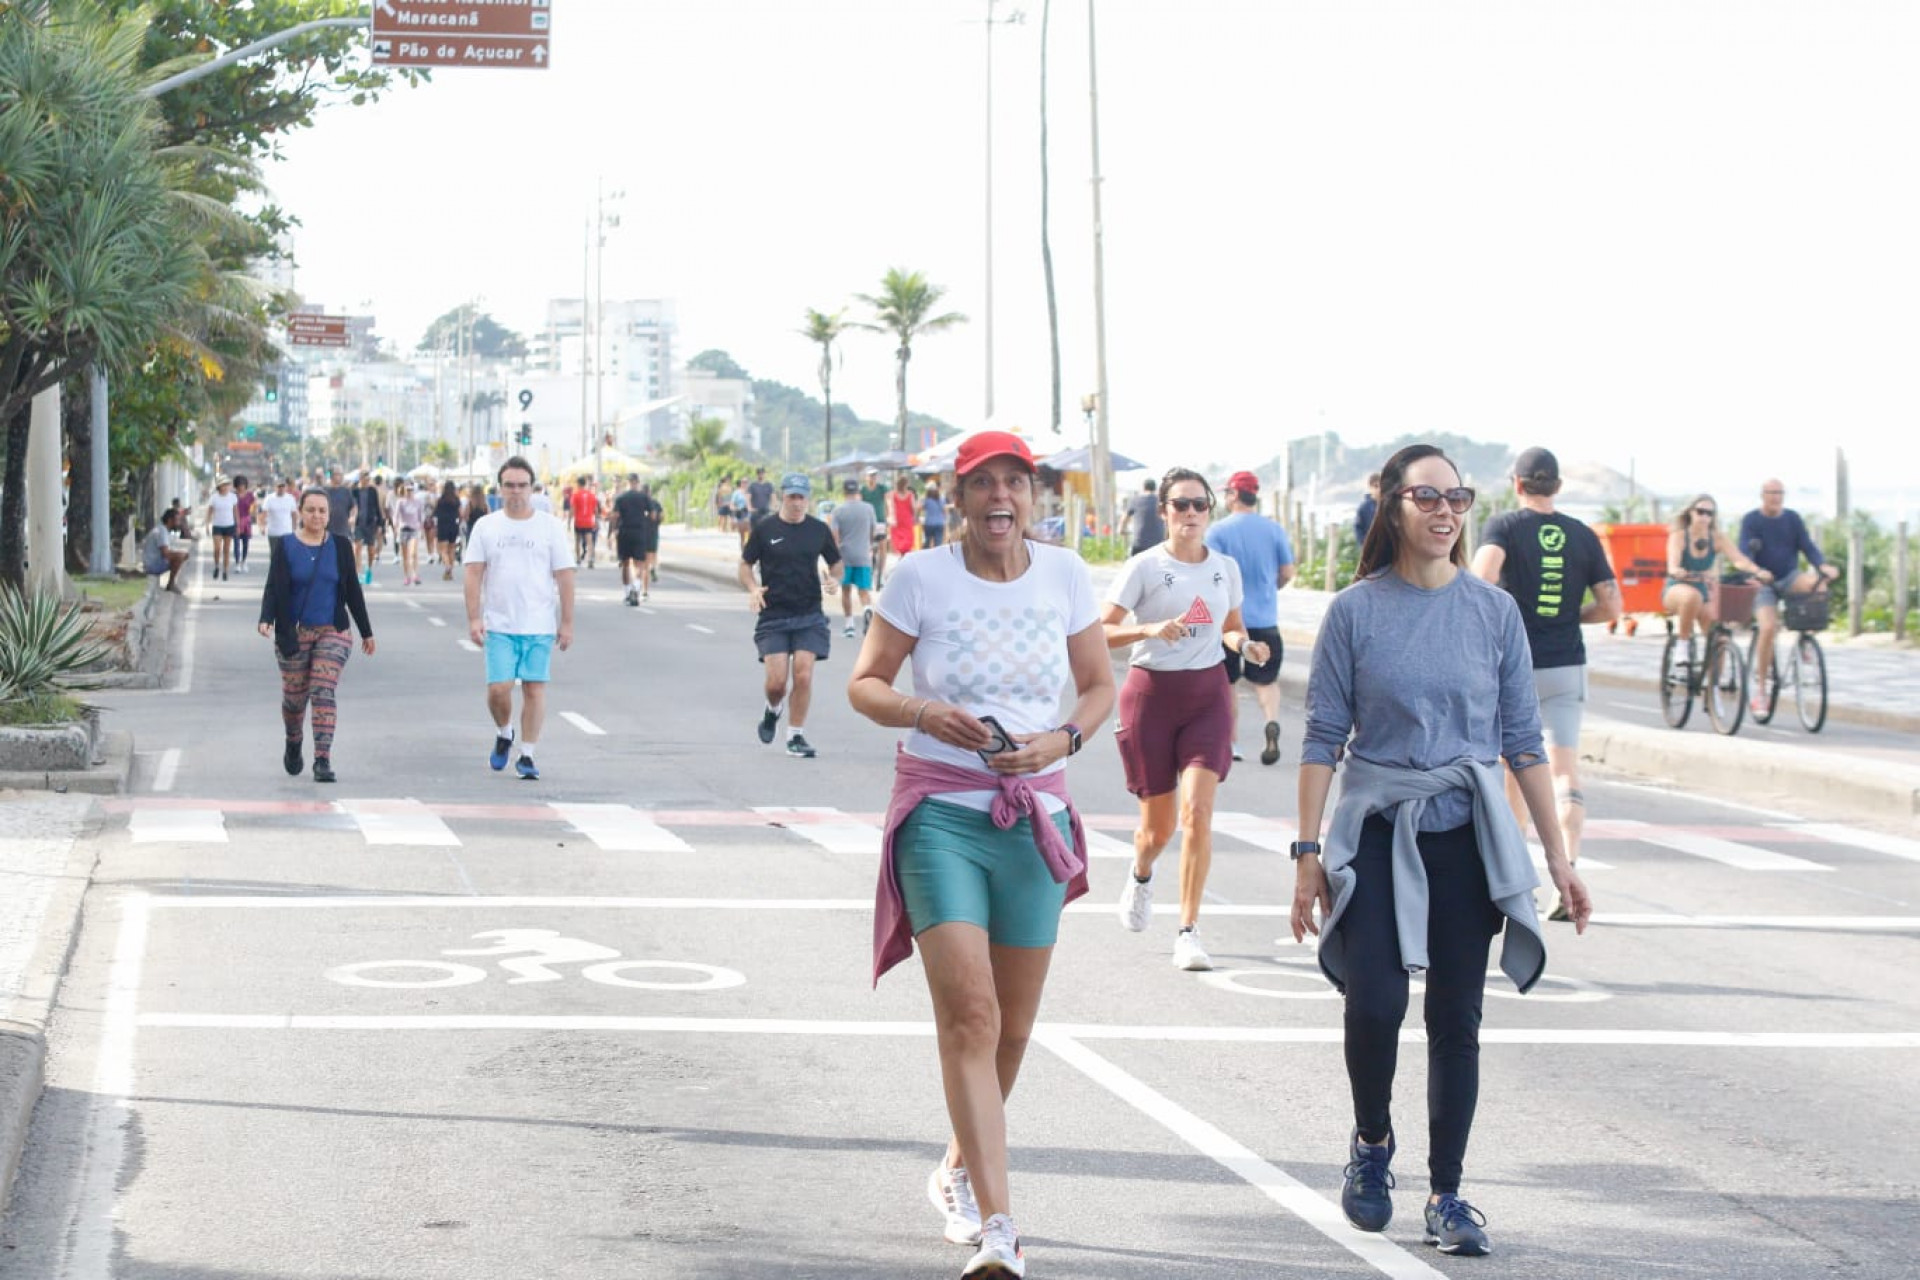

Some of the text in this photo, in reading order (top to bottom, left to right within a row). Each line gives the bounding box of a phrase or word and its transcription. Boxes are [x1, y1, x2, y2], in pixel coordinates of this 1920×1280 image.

[397, 11, 479, 26] Maracanã
[399, 43, 523, 62] Pão de Açucar
[518, 389, 533, 411] 9
